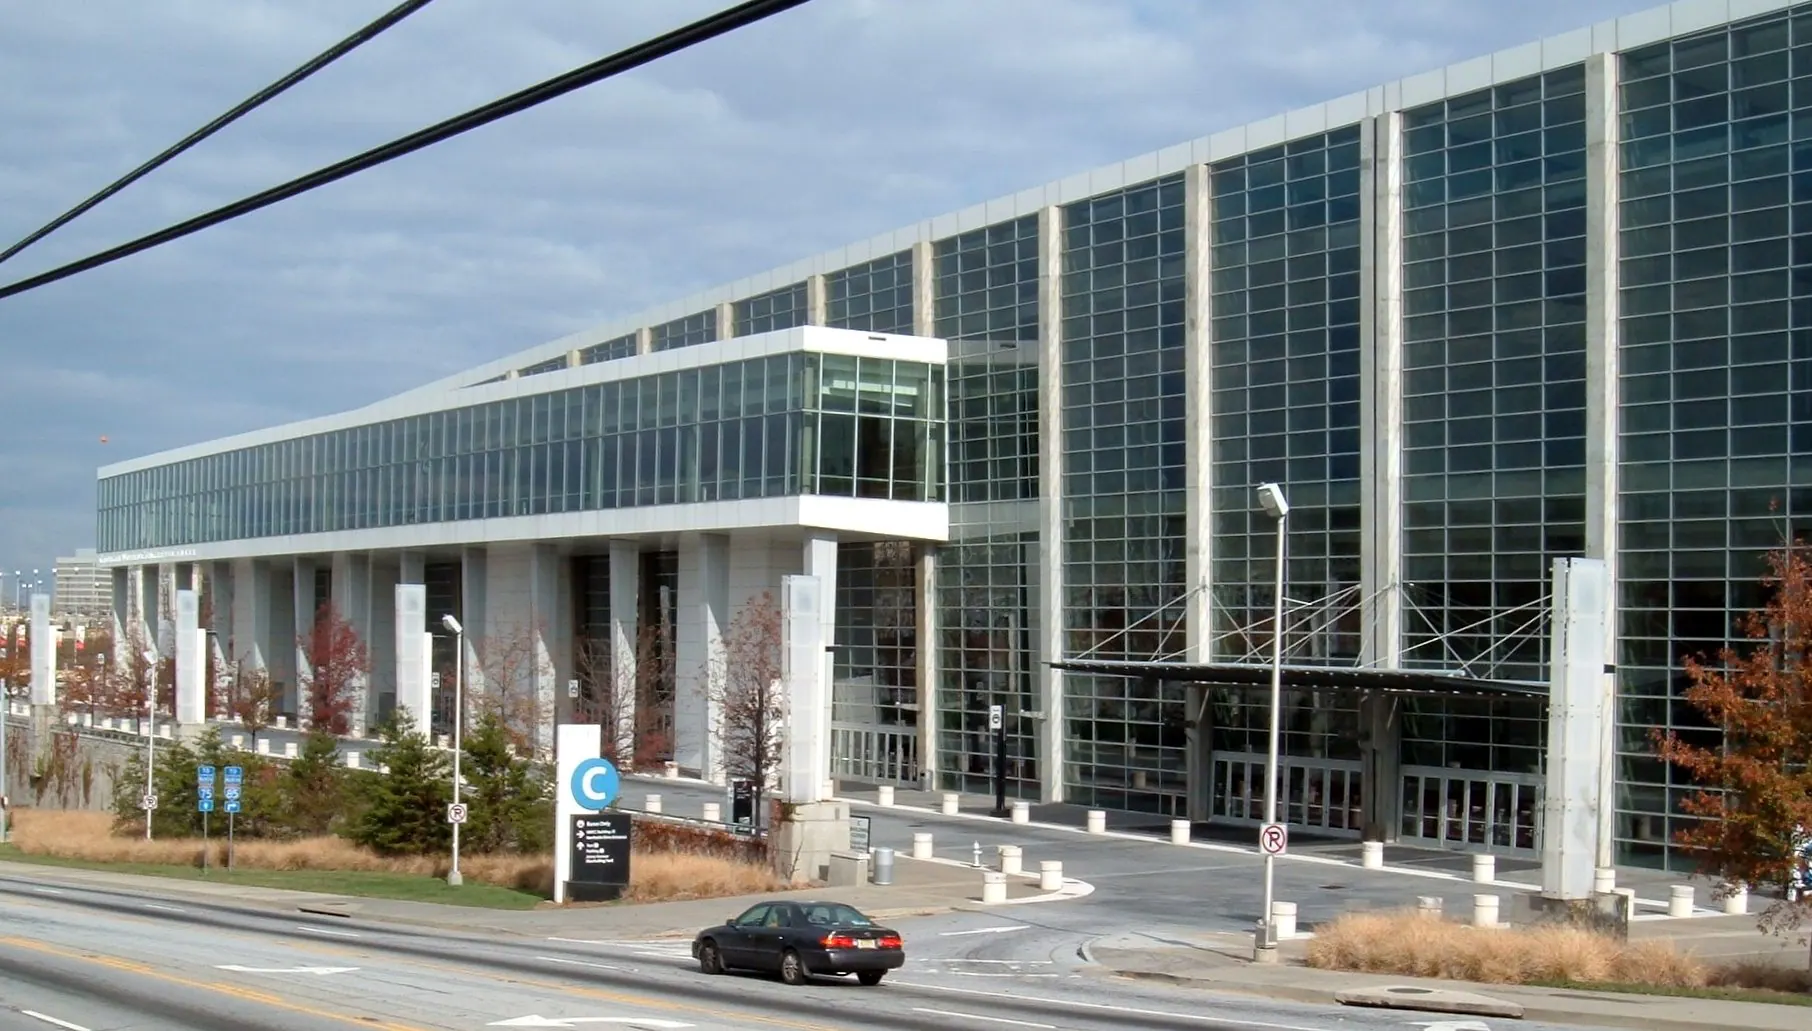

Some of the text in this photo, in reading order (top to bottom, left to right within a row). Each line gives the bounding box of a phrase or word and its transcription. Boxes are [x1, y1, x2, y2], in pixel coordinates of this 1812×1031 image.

[582, 766, 607, 801] C
[200, 788, 213, 799] 75
[225, 788, 239, 800] 85
